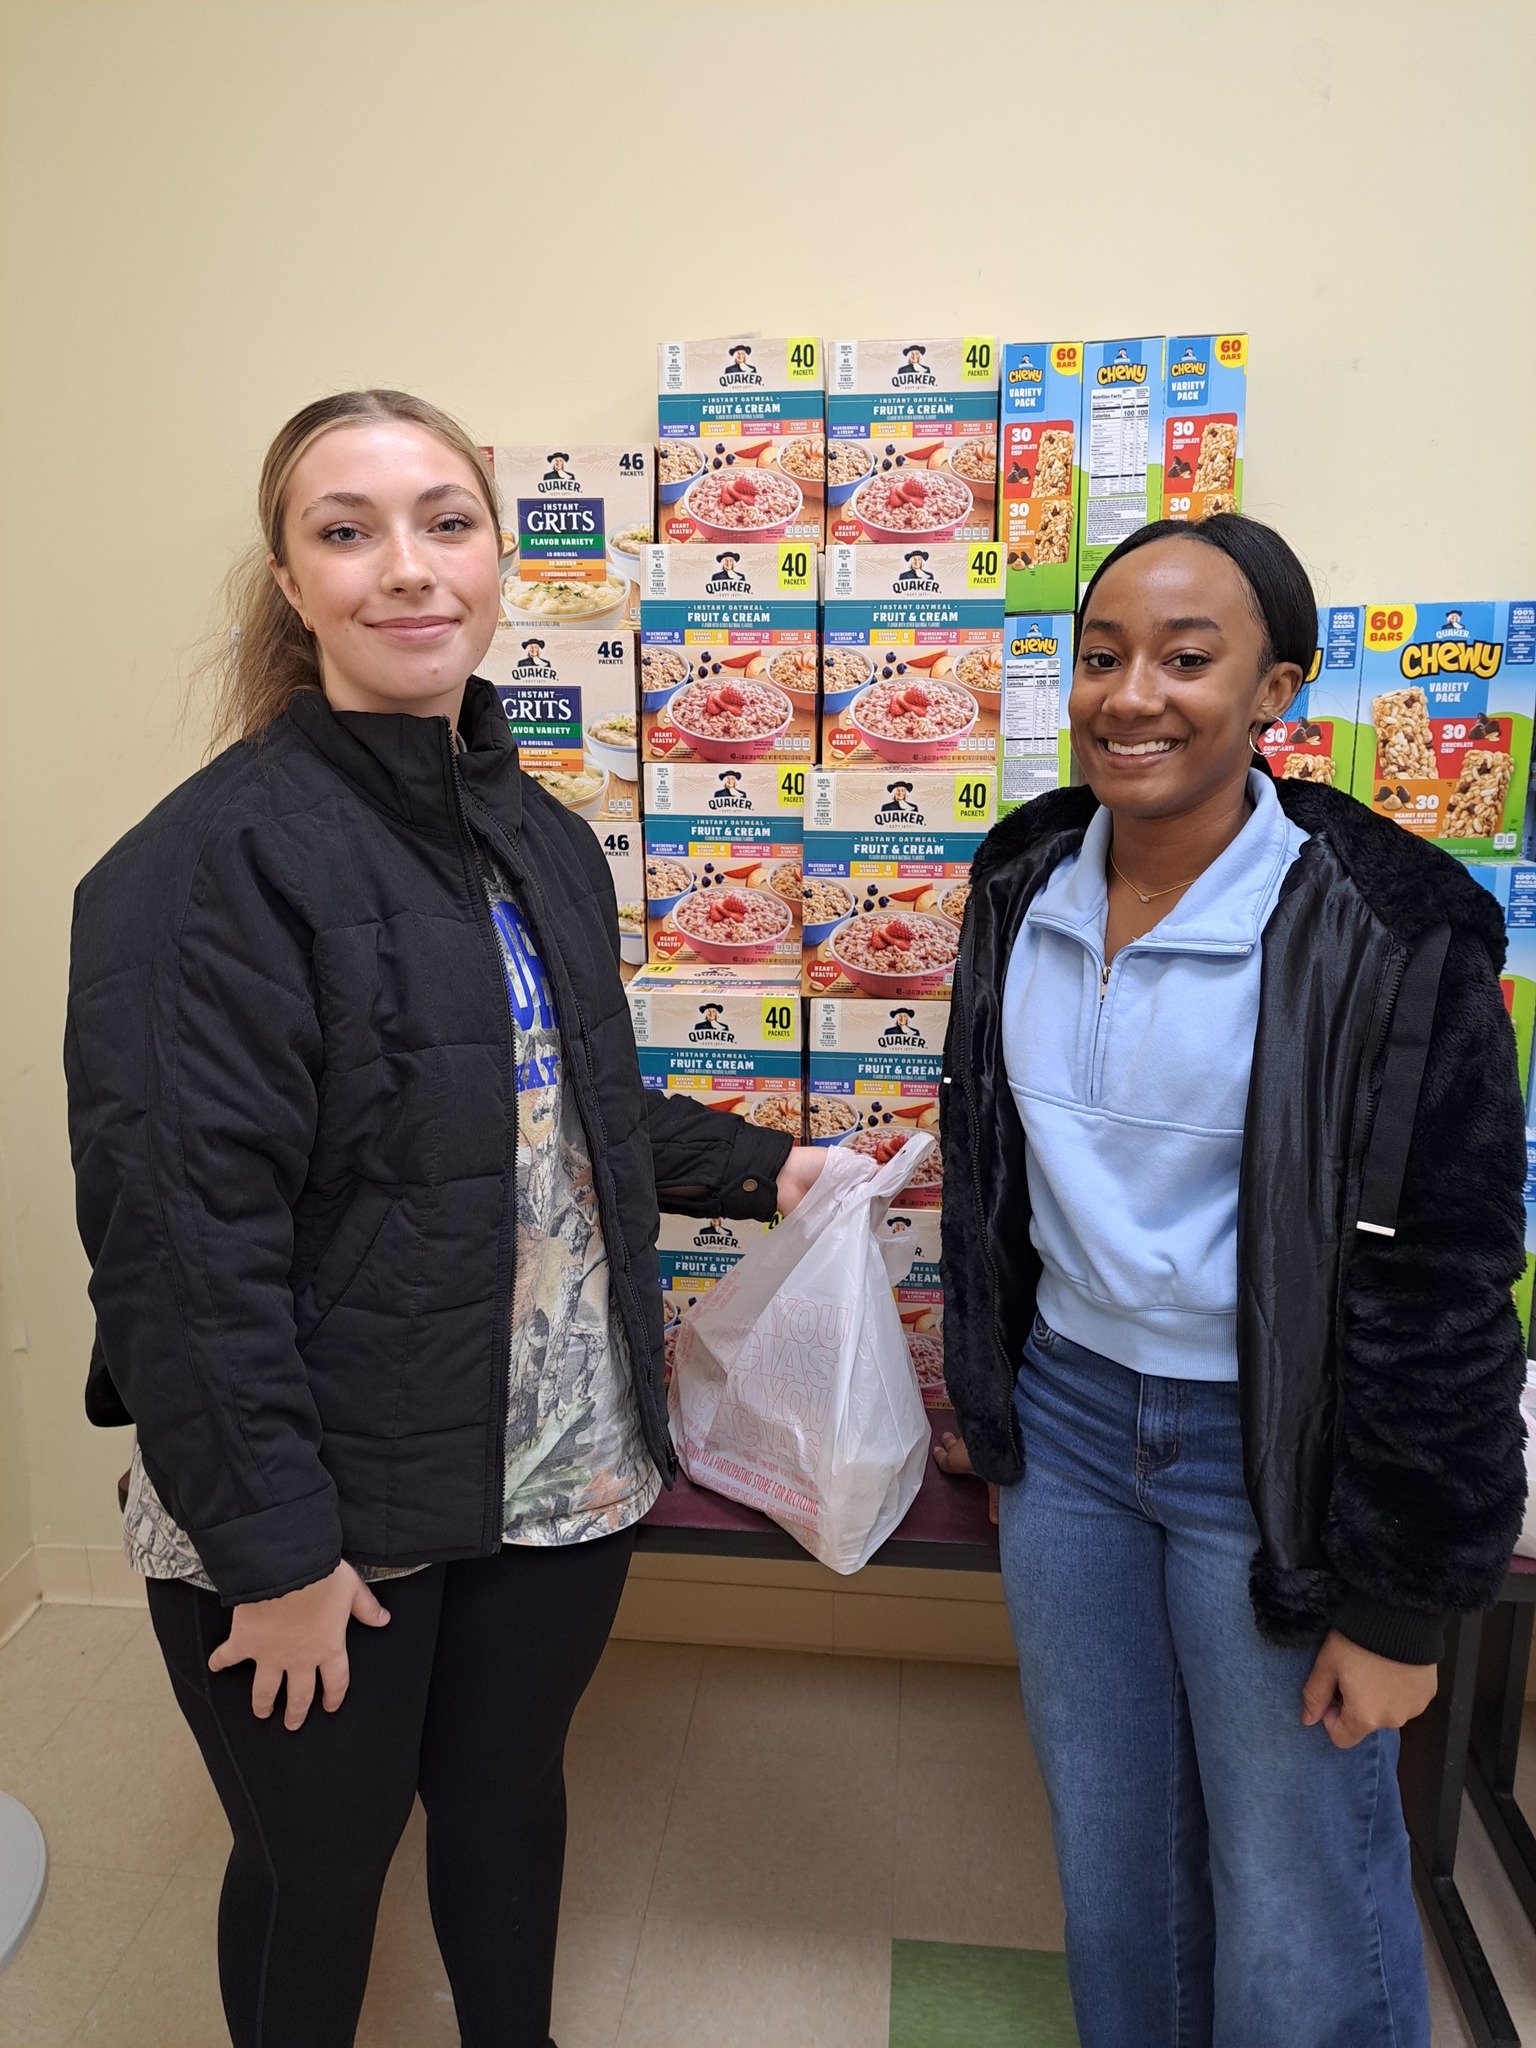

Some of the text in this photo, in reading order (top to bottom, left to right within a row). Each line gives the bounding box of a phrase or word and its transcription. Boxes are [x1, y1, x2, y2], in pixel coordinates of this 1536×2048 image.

[1221, 340, 1241, 352] 60
[791, 344, 814, 367] 40
[966, 345, 989, 368] 40
[1057, 348, 1076, 360] 60
[719, 374, 762, 386] QUAKER
[892, 374, 936, 387] QUAKER
[1172, 381, 1205, 391] VARIETY
[1009, 388, 1042, 397] VARIETY
[1177, 391, 1198, 401] PACK
[1015, 398, 1036, 407] PACK
[703, 404, 780, 414] FRUIT & CREAM
[874, 405, 953, 415] FRUIT CREAM
[1173, 421, 1194, 436] 30
[1012, 428, 1032, 442] 30
[619, 453, 644, 470] 46
[538, 481, 580, 493] QUAKER
[1009, 503, 1029, 516] 30
[1170, 498, 1190, 511] 30
[527, 511, 595, 533] GRITS
[782, 553, 806, 577] 40
[972, 551, 997, 575] 40
[706, 581, 751, 594] QUAKER
[893, 581, 939, 593] QUAKER
[688, 612, 770, 622] FRUIT CREAM
[873, 612, 958, 622] FRUIT CREAM
[1371, 611, 1403, 630] 60
[1370, 633, 1402, 641] BARS
[1436, 629, 1469, 638] QUAKER
[597, 641, 623, 658] 46
[512, 668, 557, 680] QUAKER
[1430, 682, 1469, 692] VARIETY
[1436, 693, 1461, 702] PACK
[502, 698, 572, 721] GRITS
[1264, 728, 1286, 743] 30
[1442, 724, 1466, 739] 30
[782, 773, 804, 795] 40
[959, 783, 986, 808] 40
[709, 798, 752, 810] QUAKER
[1415, 795, 1439, 810] 30
[875, 812, 924, 825] QUAKER
[691, 827, 770, 836] FRUIT CREAM
[604, 835, 629, 850] 46
[854, 844, 944, 854] FRUIT & CREAM
[766, 1007, 790, 1029] 40
[689, 1032, 735, 1043] QUAKER
[878, 1036, 926, 1048] QUAKER
[671, 1059, 754, 1069] FRUIT CREAM
[858, 1064, 891, 1074] FRUIT
[693, 1236, 739, 1247] QUAKER
[676, 1262, 706, 1271] FRUIT
[773, 1298, 848, 1350] YOU
[715, 1457, 753, 1486] PARTICIPATING
[752, 1474, 773, 1494] STORE
[771, 1482, 785, 1500] FOR
[785, 1489, 818, 1516] RECYCLING
